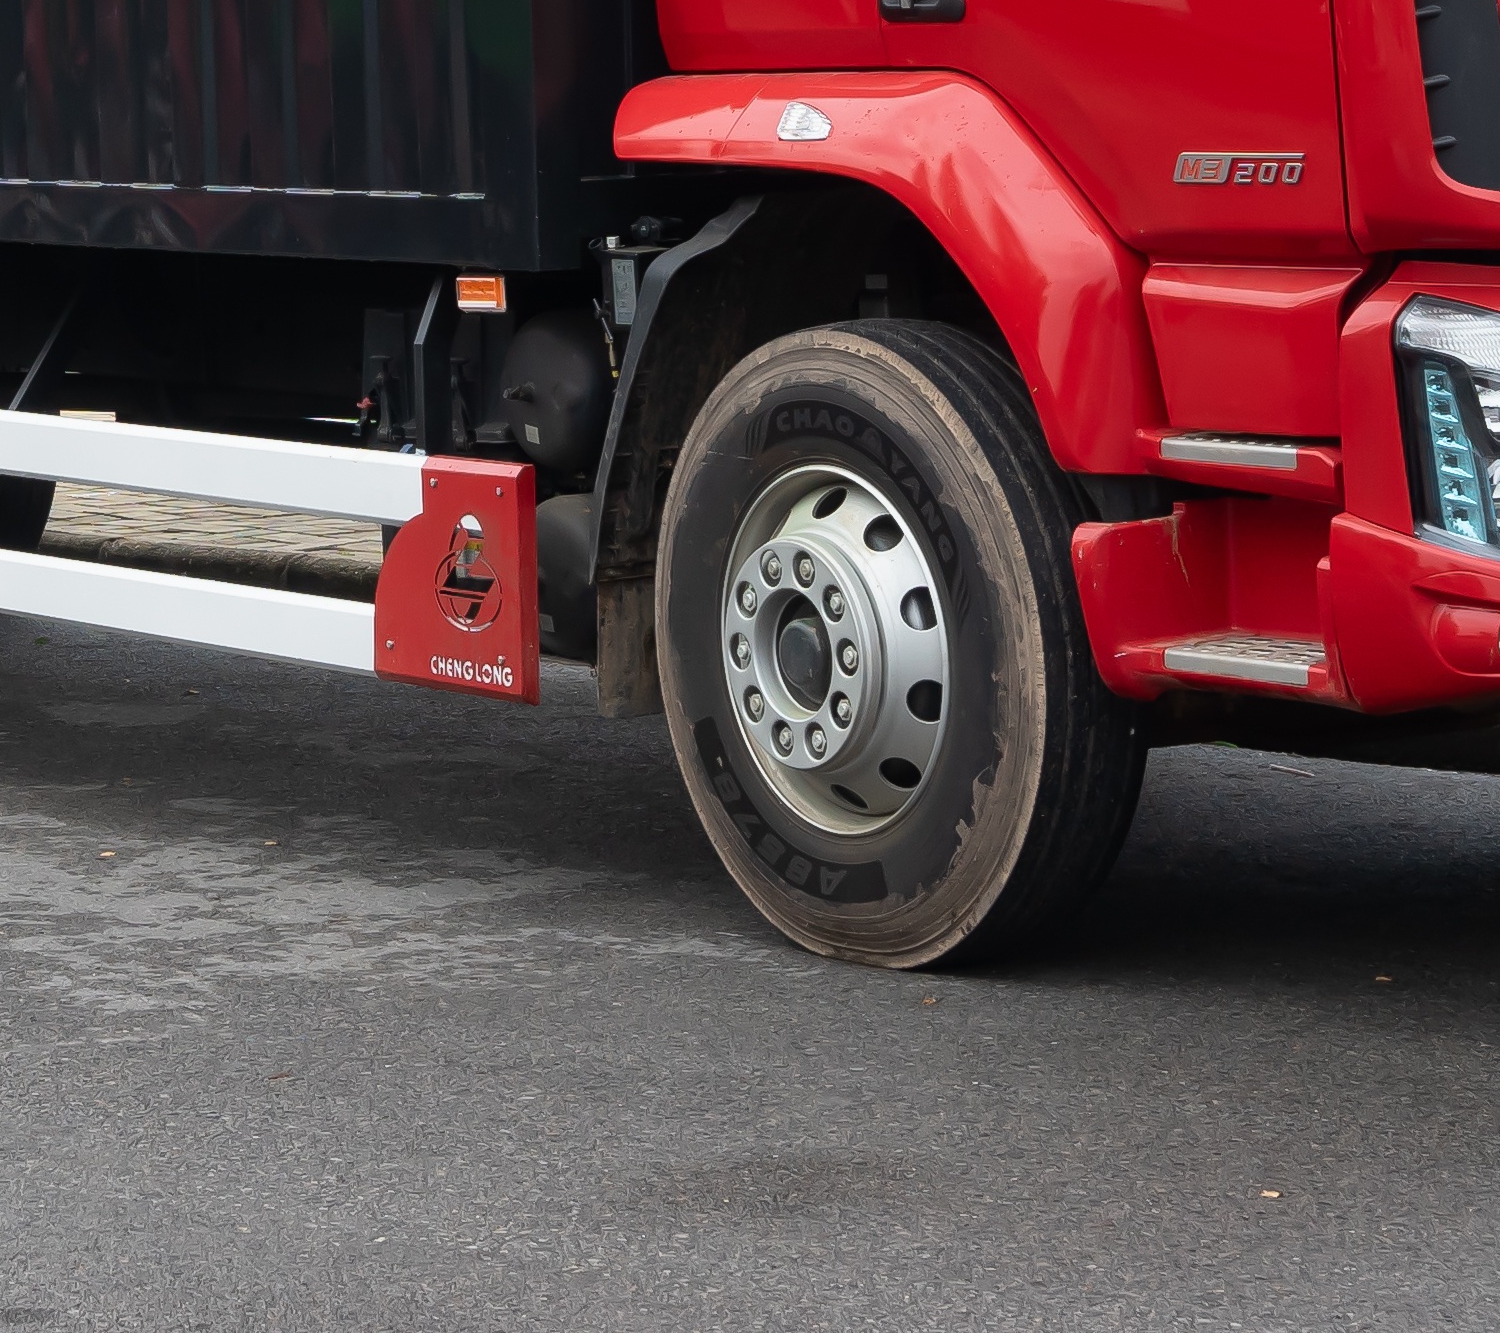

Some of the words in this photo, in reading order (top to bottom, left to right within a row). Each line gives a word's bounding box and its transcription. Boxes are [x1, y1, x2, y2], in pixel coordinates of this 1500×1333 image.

[1233, 162, 1304, 184] 200
[430, 655, 474, 681] CHENG
[475, 662, 513, 687] LONG
